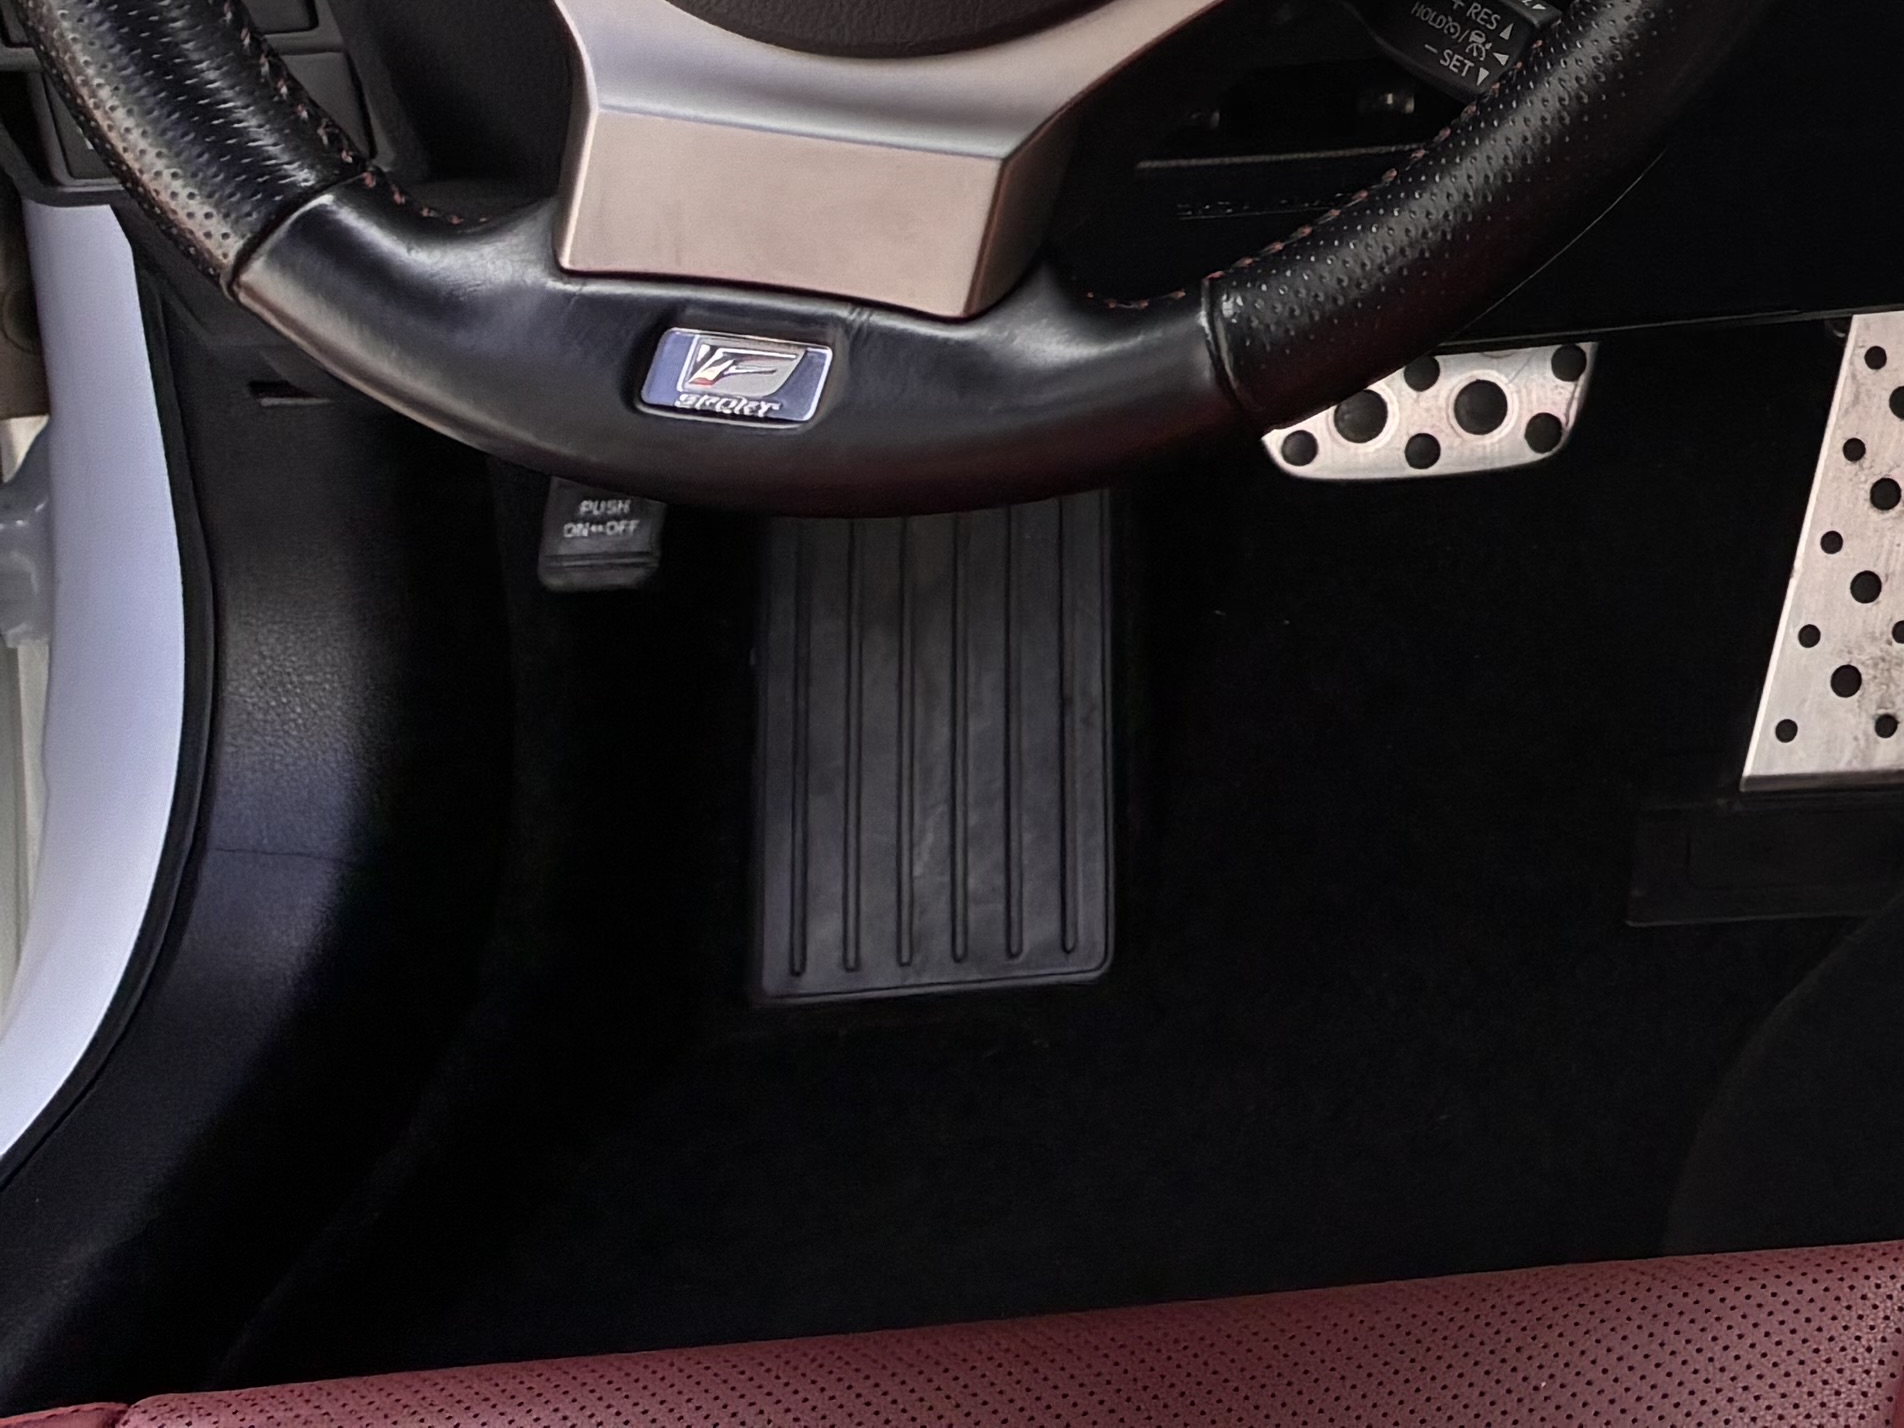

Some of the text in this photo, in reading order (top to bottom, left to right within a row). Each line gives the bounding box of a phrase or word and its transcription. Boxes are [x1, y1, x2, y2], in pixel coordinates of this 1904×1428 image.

[1411, 0, 1447, 30] HOLD
[1466, 1, 1501, 30] RES
[1440, 48, 1475, 77] SET
[579, 498, 632, 516] PUSH
